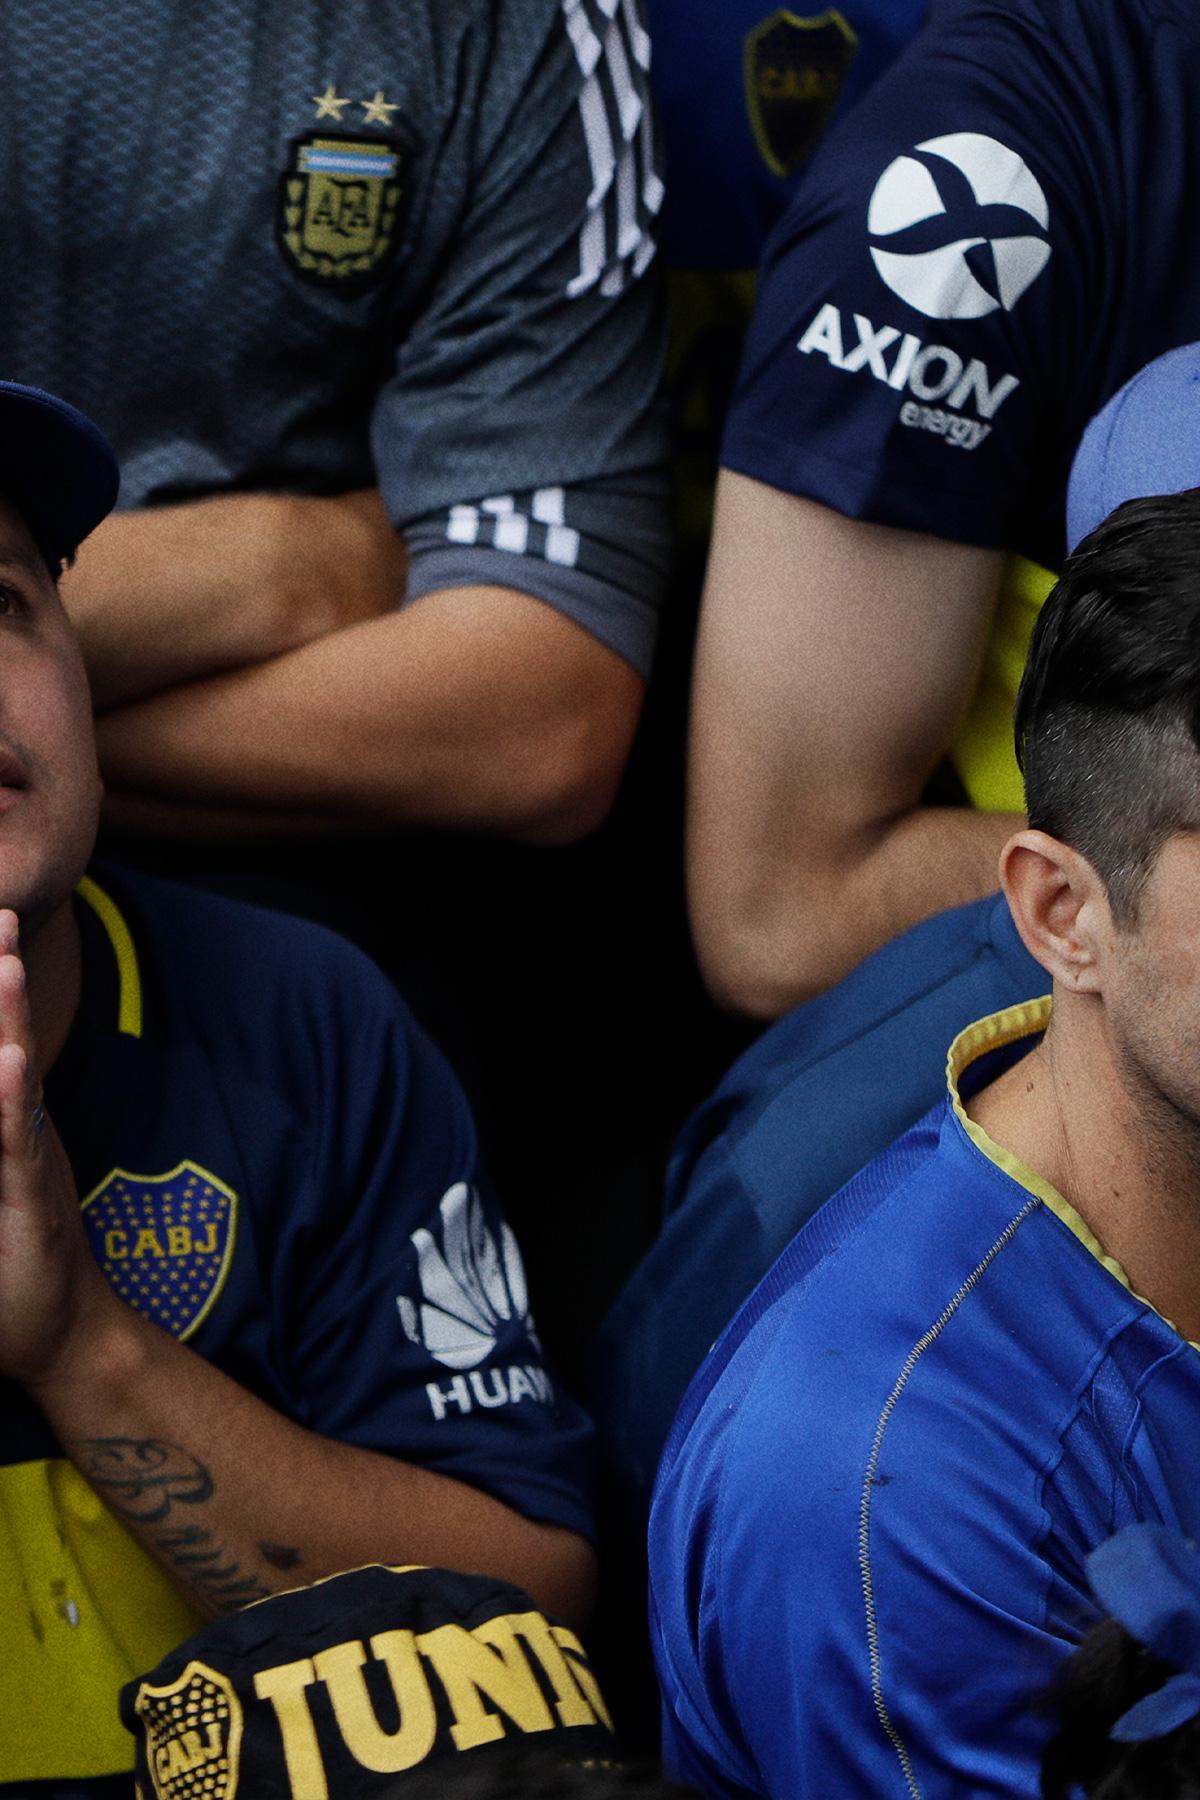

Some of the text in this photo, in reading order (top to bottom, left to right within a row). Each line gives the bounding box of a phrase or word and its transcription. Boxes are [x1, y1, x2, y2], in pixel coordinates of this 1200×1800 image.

[796, 303, 1020, 419] AXION
[899, 401, 992, 450] energy
[104, 1222, 218, 1260] CABJ
